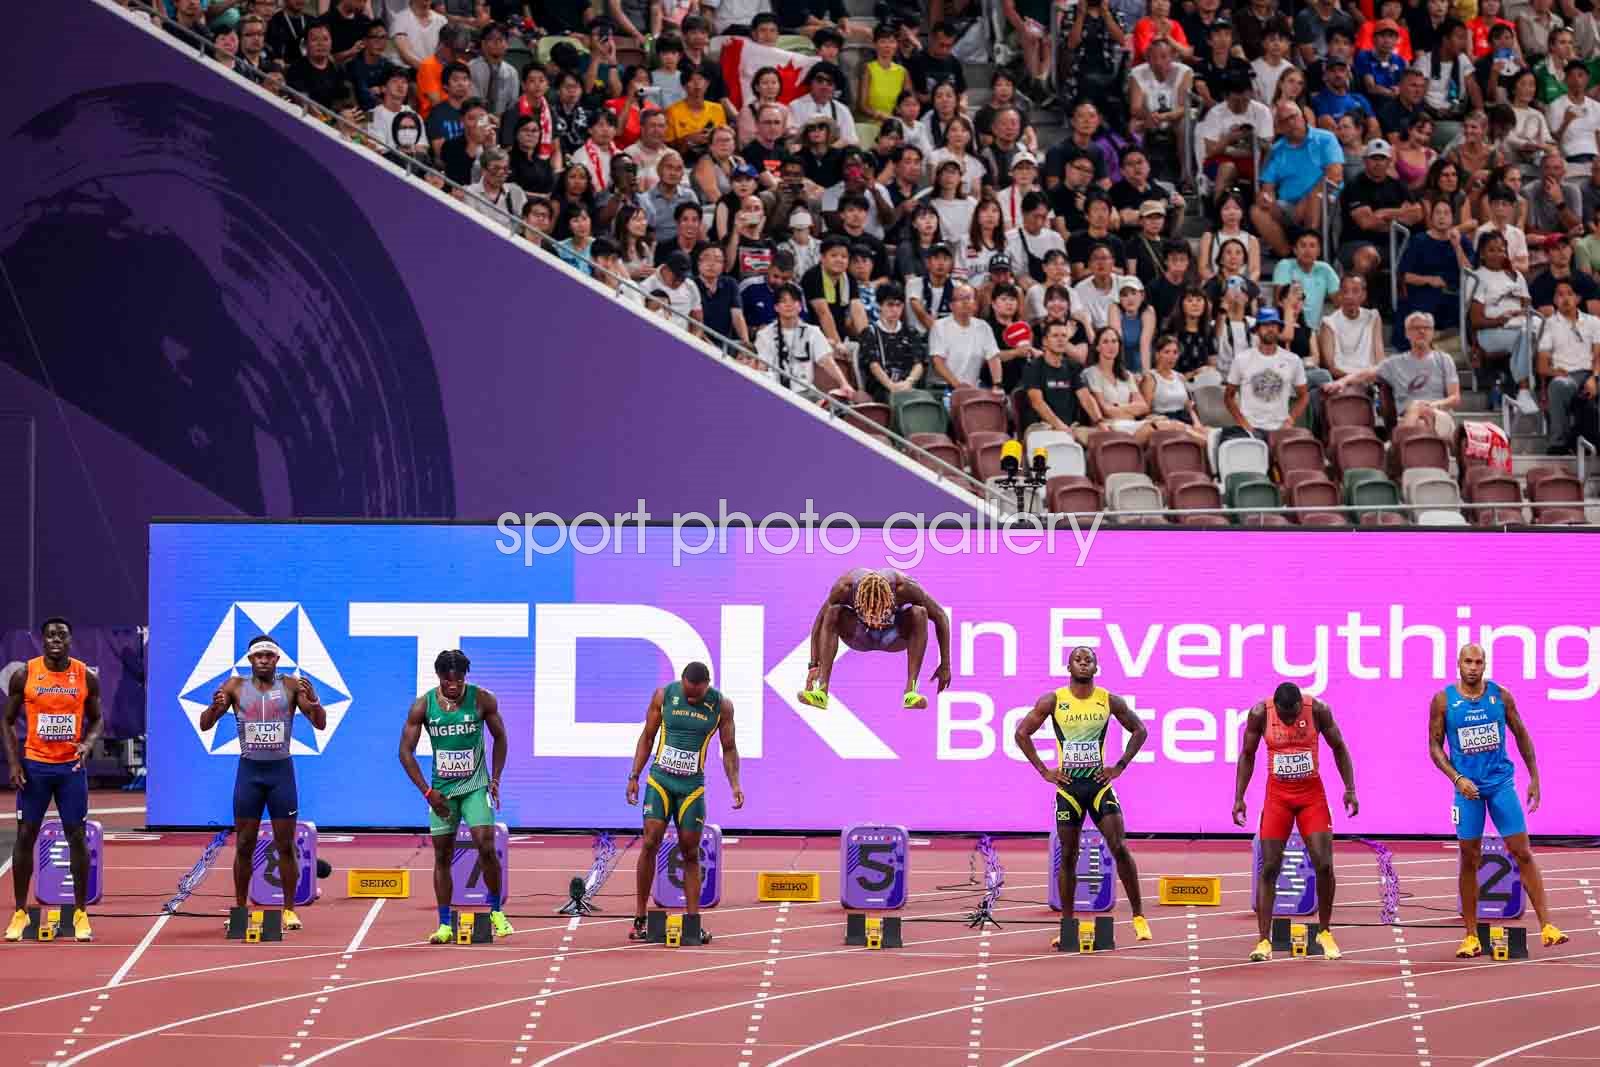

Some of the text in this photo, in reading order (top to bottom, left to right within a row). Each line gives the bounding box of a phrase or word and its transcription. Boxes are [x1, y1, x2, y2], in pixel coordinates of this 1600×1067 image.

[943, 604, 1600, 702] n Everything
[349, 602, 899, 760] TDK
[48, 715, 73, 723] TDK
[1065, 713, 1104, 722] JAMAICA
[40, 725, 73, 734] AFRIFA
[256, 723, 281, 732] TDK
[429, 724, 476, 736] NIGERIA
[936, 690, 1249, 762] Beter
[1469, 724, 1496, 736] TDK
[254, 734, 276, 742] AZU
[1463, 735, 1498, 748] JACOBS
[1073, 742, 1097, 751] TDK
[447, 751, 471, 760] TDK
[673, 751, 696, 761] TDK
[1074, 752, 1099, 761] BLAKE
[1286, 753, 1309, 763] TDK
[440, 761, 470, 770] AJAYI
[661, 756, 697, 771] SIMBINE
[1277, 762, 1311, 774] ADJIBI
[856, 844, 895, 892] 5
[1477, 853, 1512, 901] 2
[360, 879, 398, 888] SEIKO
[770, 882, 808, 891] SEIKO
[1171, 886, 1208, 895] SEIKO
